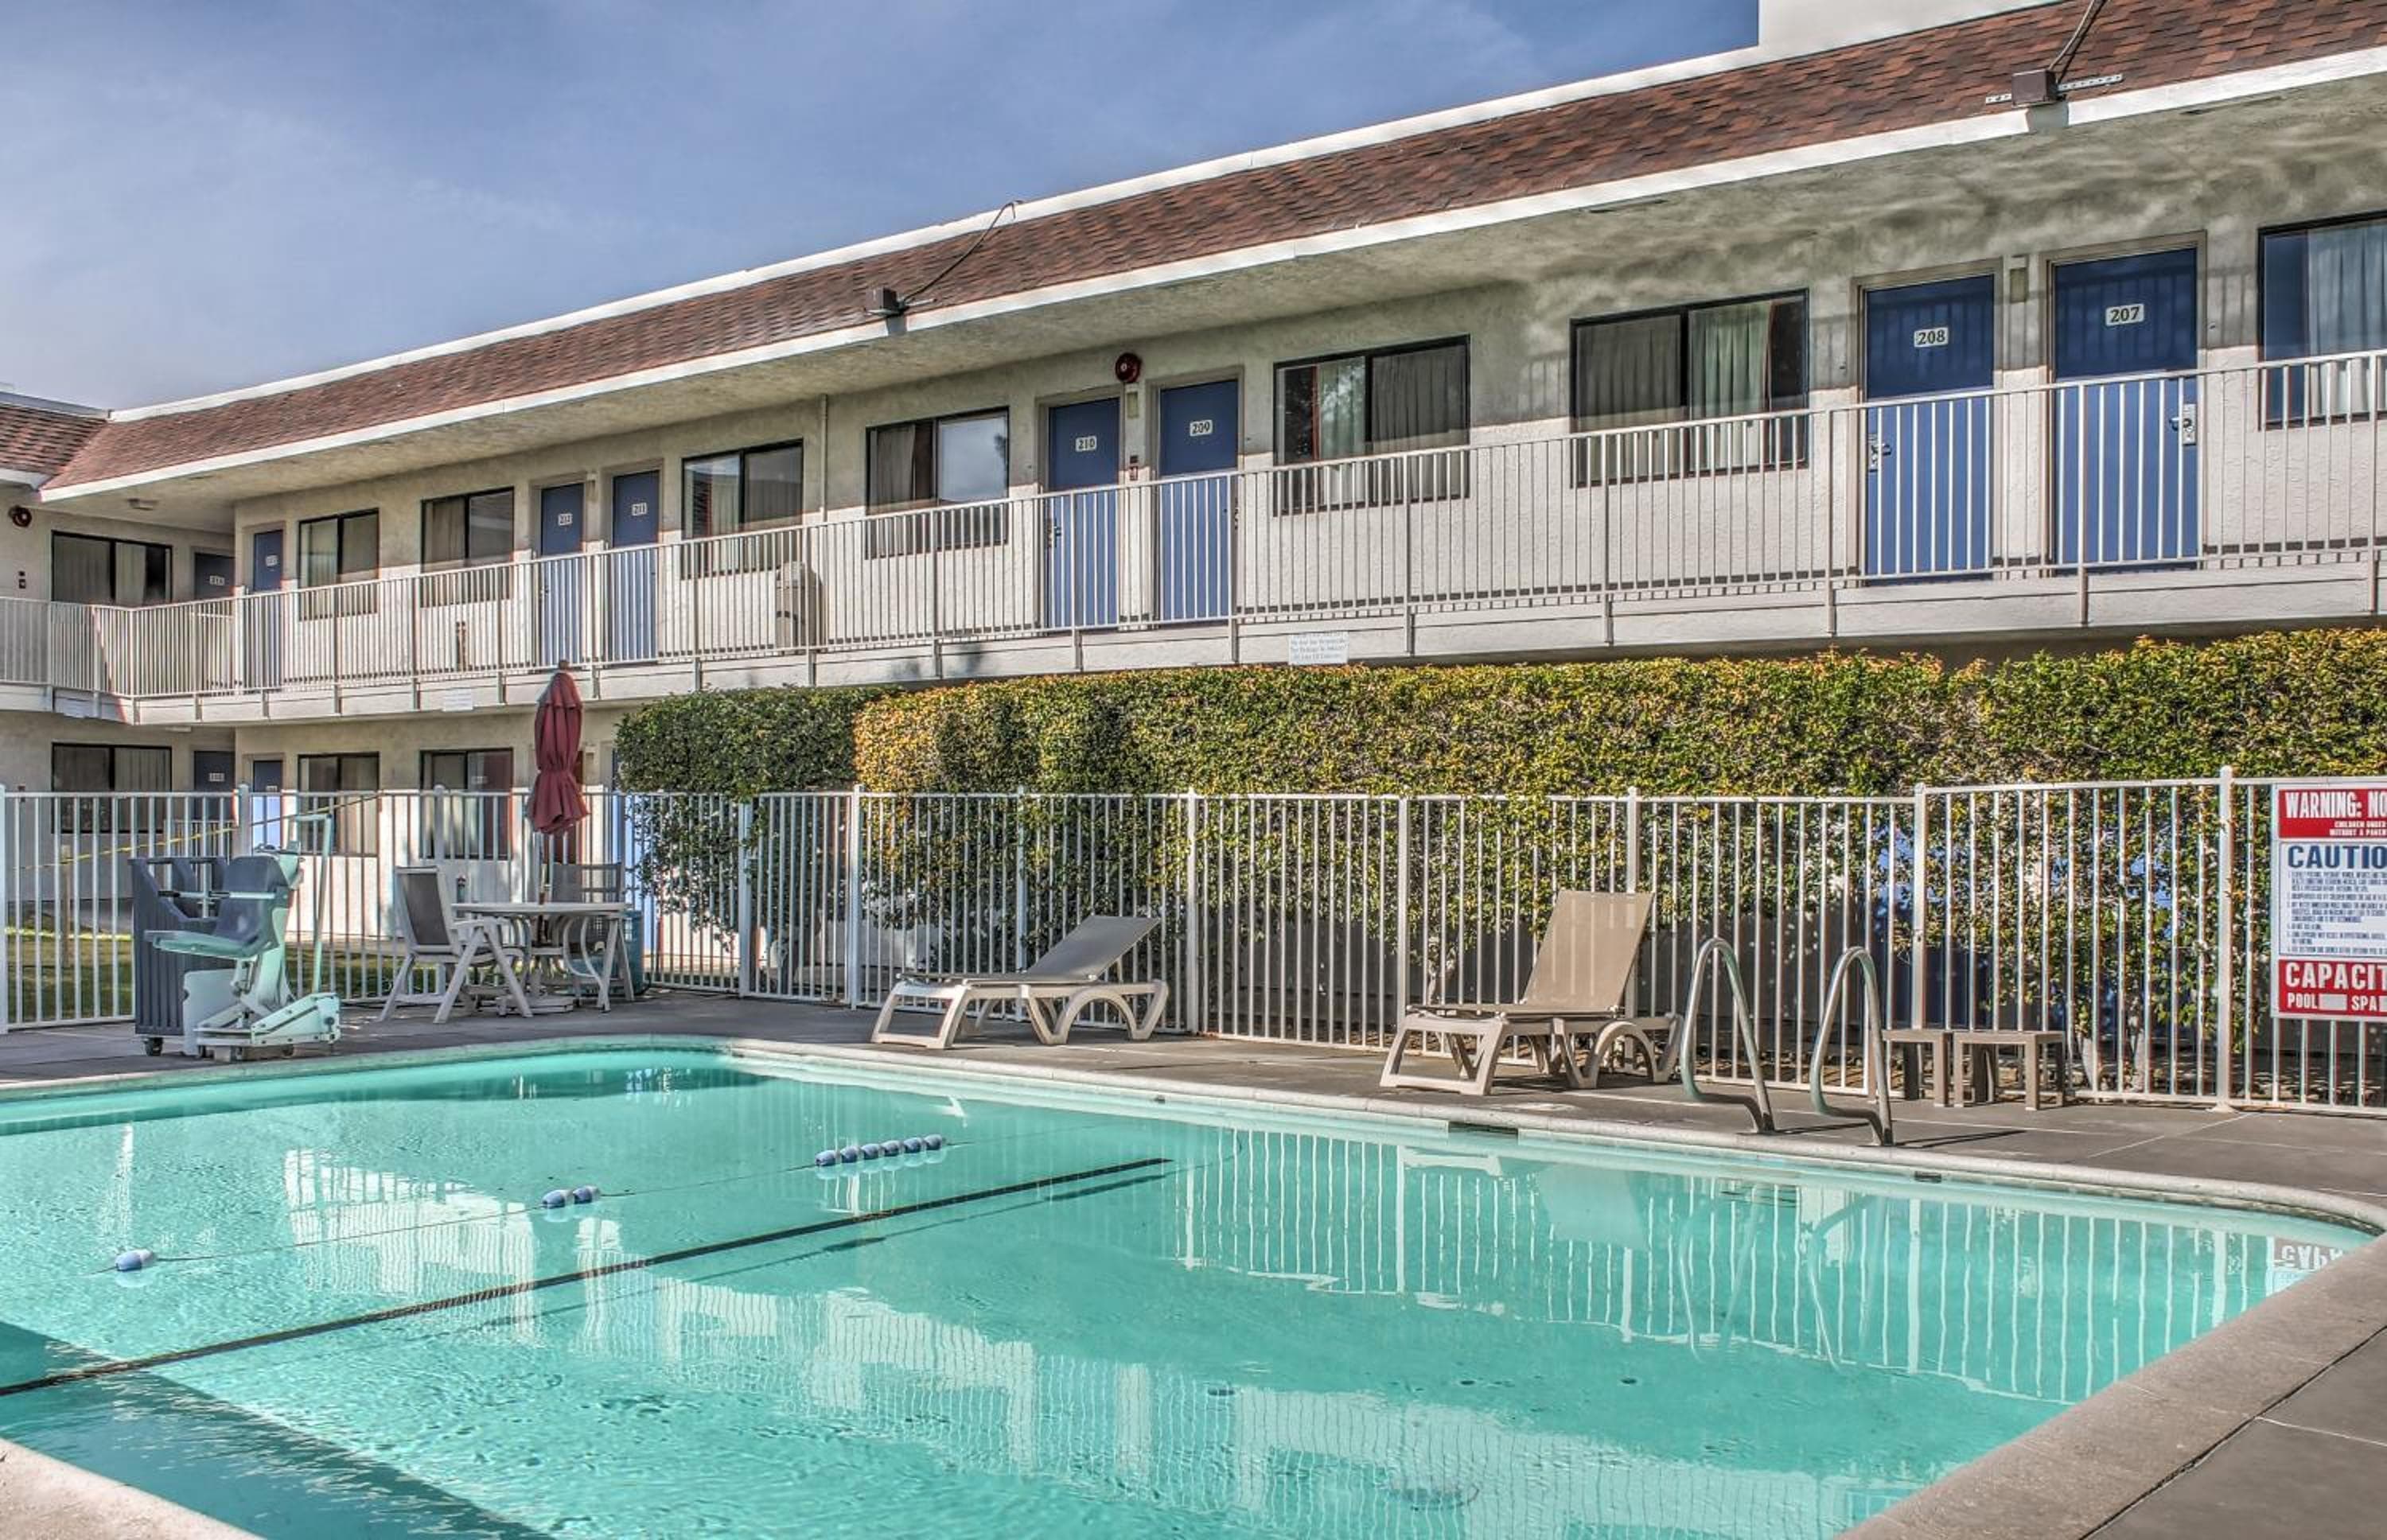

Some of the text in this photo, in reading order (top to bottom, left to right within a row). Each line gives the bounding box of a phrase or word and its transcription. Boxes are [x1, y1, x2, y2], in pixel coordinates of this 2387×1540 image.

[2109, 306, 2140, 323] 207
[1918, 329, 1945, 345] 208
[1192, 421, 1210, 434] 209
[1078, 438, 1095, 450] 210
[2285, 791, 2362, 819] WARNING:
[2288, 993, 2377, 1011] POOL SPA
